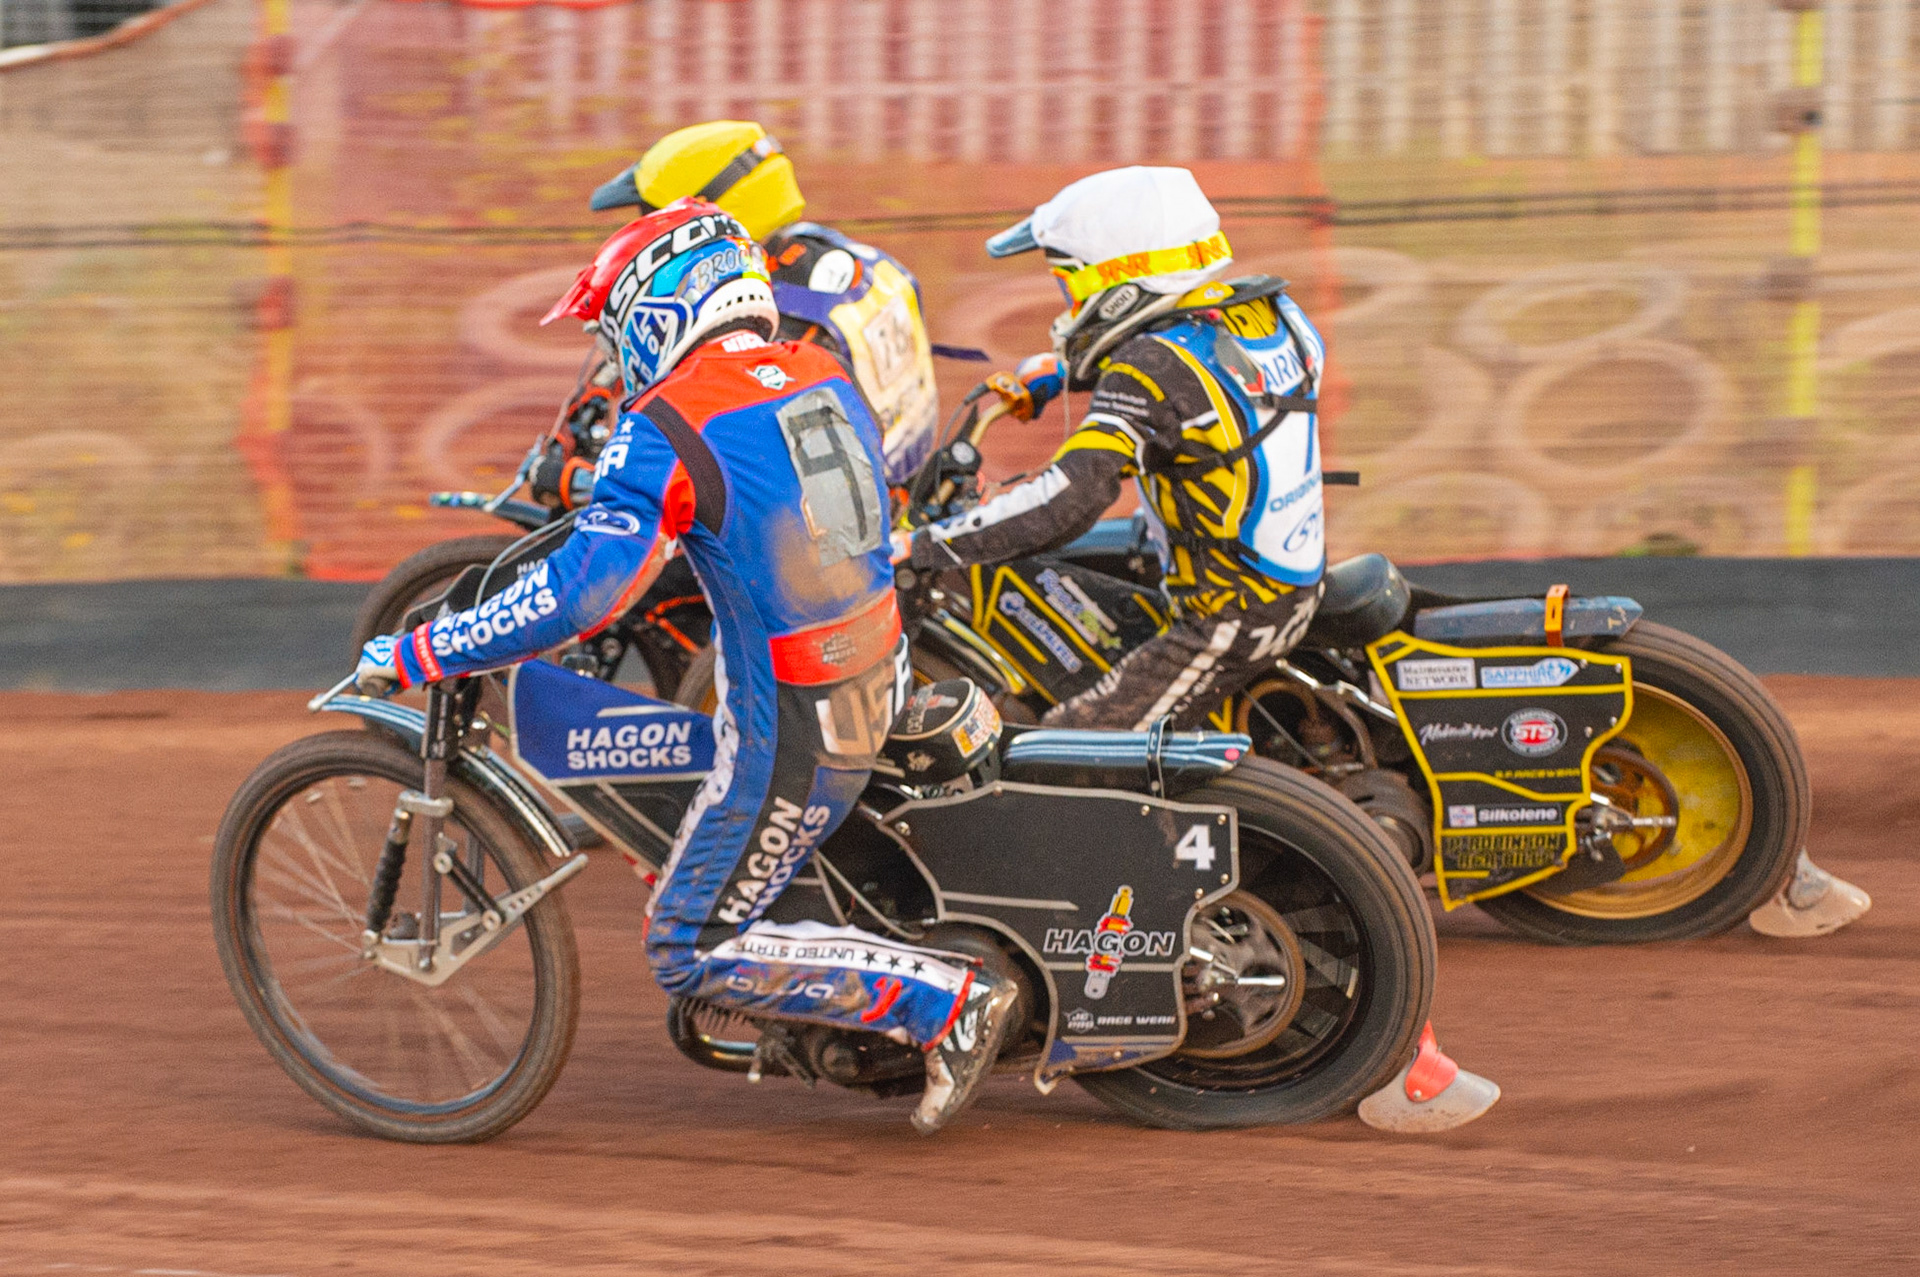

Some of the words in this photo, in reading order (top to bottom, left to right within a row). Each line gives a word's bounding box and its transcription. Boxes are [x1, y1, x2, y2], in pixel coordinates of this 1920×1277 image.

[432, 588, 558, 657] SHOCKS
[567, 722, 692, 750] HAGON
[1515, 724, 1555, 740] STS
[567, 745, 692, 770] SHOCKS
[1478, 807, 1558, 822] Silkolene
[718, 796, 803, 924] HAGON
[1175, 824, 1216, 870] 4
[747, 805, 831, 920] SHOCKS
[795, 945, 856, 962] UNITED
[1043, 928, 1176, 956] HAGON
